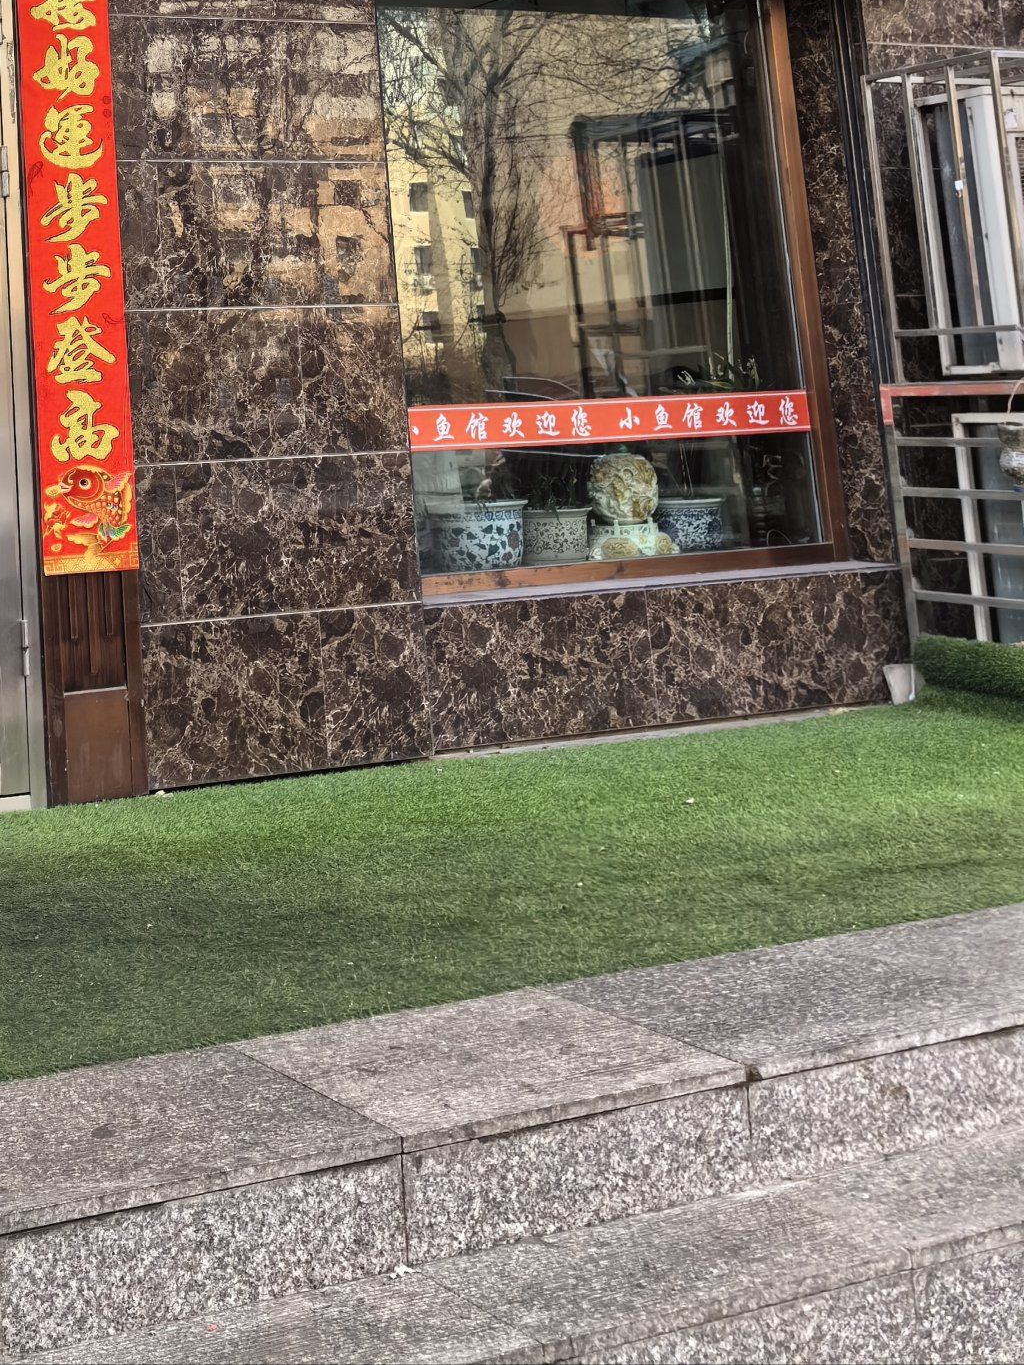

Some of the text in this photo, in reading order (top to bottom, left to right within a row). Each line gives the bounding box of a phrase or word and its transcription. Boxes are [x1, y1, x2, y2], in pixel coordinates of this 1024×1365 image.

[410, 405, 592, 443] 鱼馆欢迎您
[618, 395, 799, 433] 小鱼馆欢迎您
